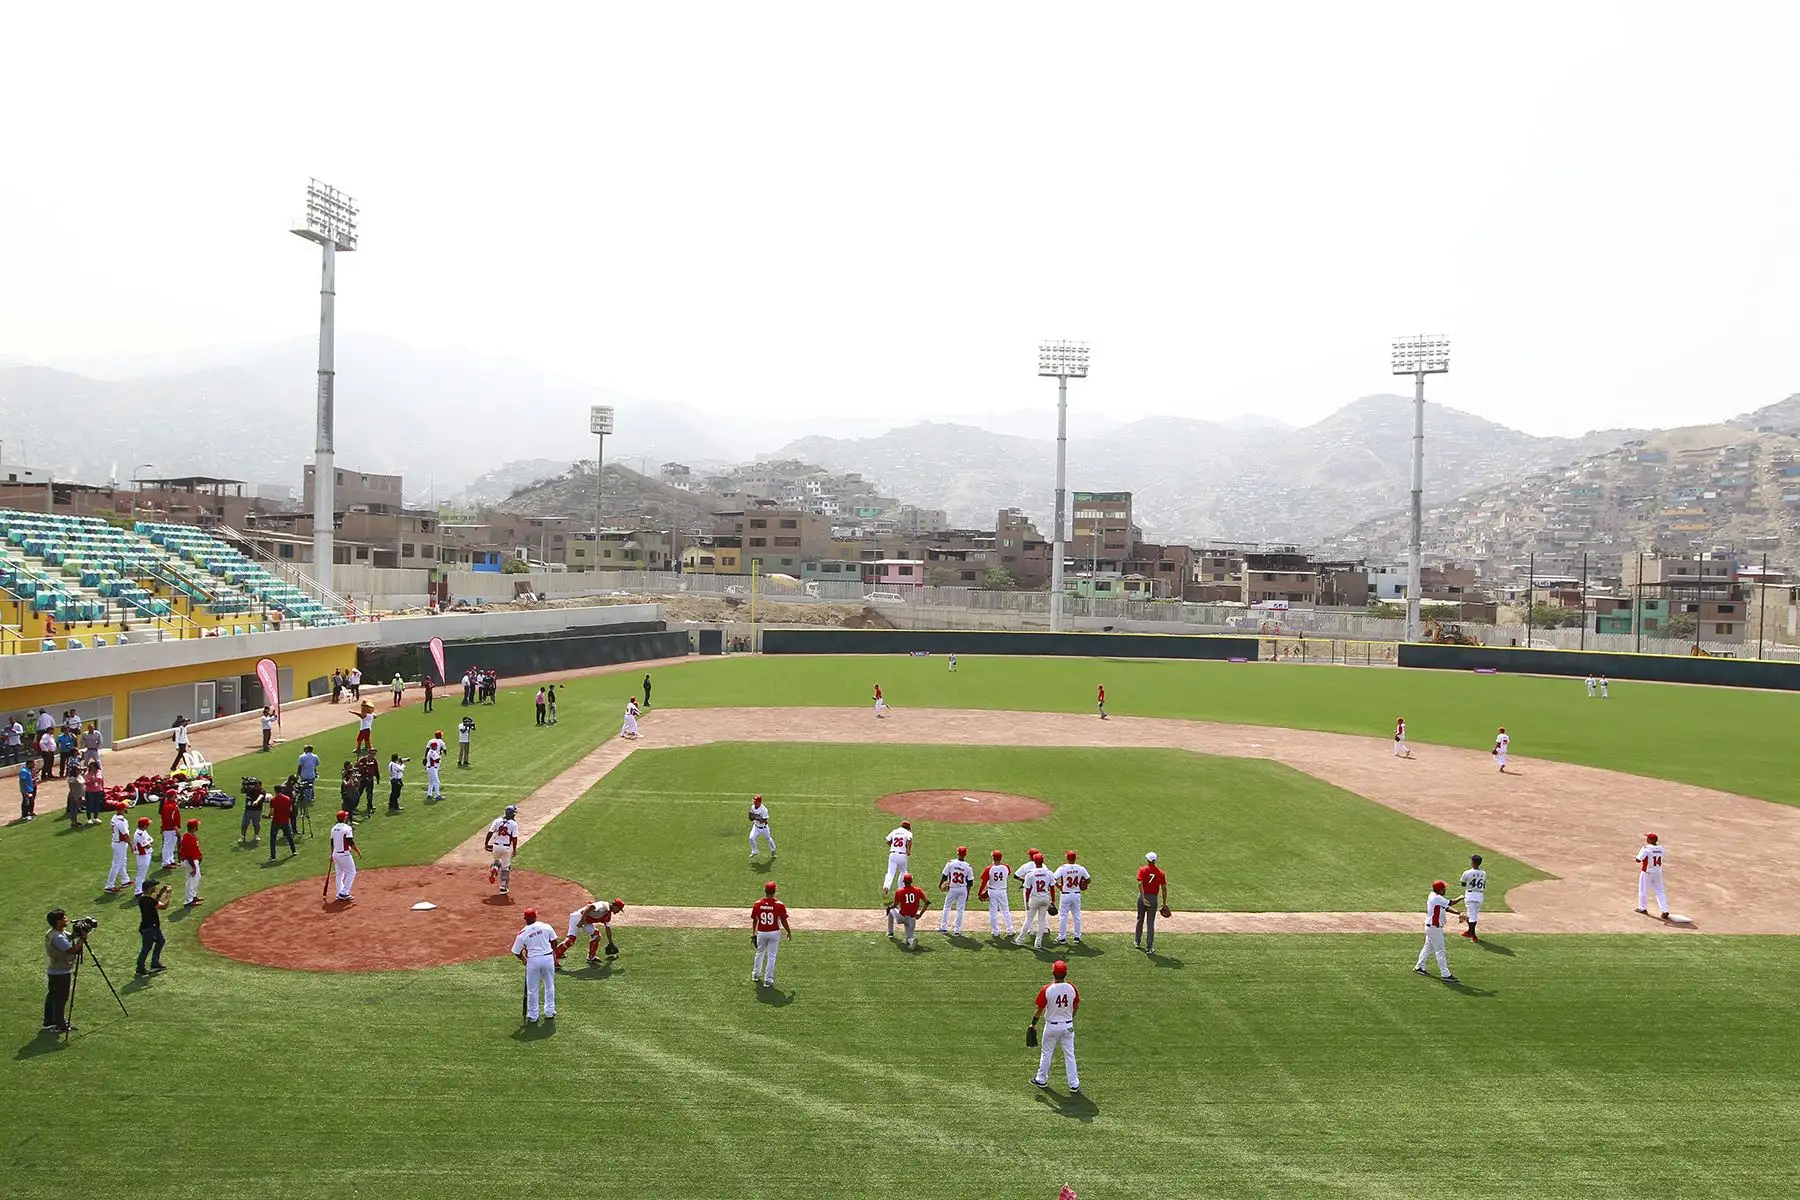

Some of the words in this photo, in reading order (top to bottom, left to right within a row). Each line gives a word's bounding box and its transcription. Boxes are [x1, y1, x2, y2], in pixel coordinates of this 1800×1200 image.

[893, 837, 904, 848] 26
[1652, 856, 1662, 867] 14
[952, 872, 965, 884] 33
[993, 872, 1003, 882] 54
[1066, 876, 1079, 888] 34
[1149, 873, 1155, 884] 7
[1036, 880, 1046, 892] 12
[1469, 878, 1483, 889] 46
[905, 893, 915, 904] 10
[760, 912, 774, 925] 99
[1055, 994, 1069, 1008] 44
